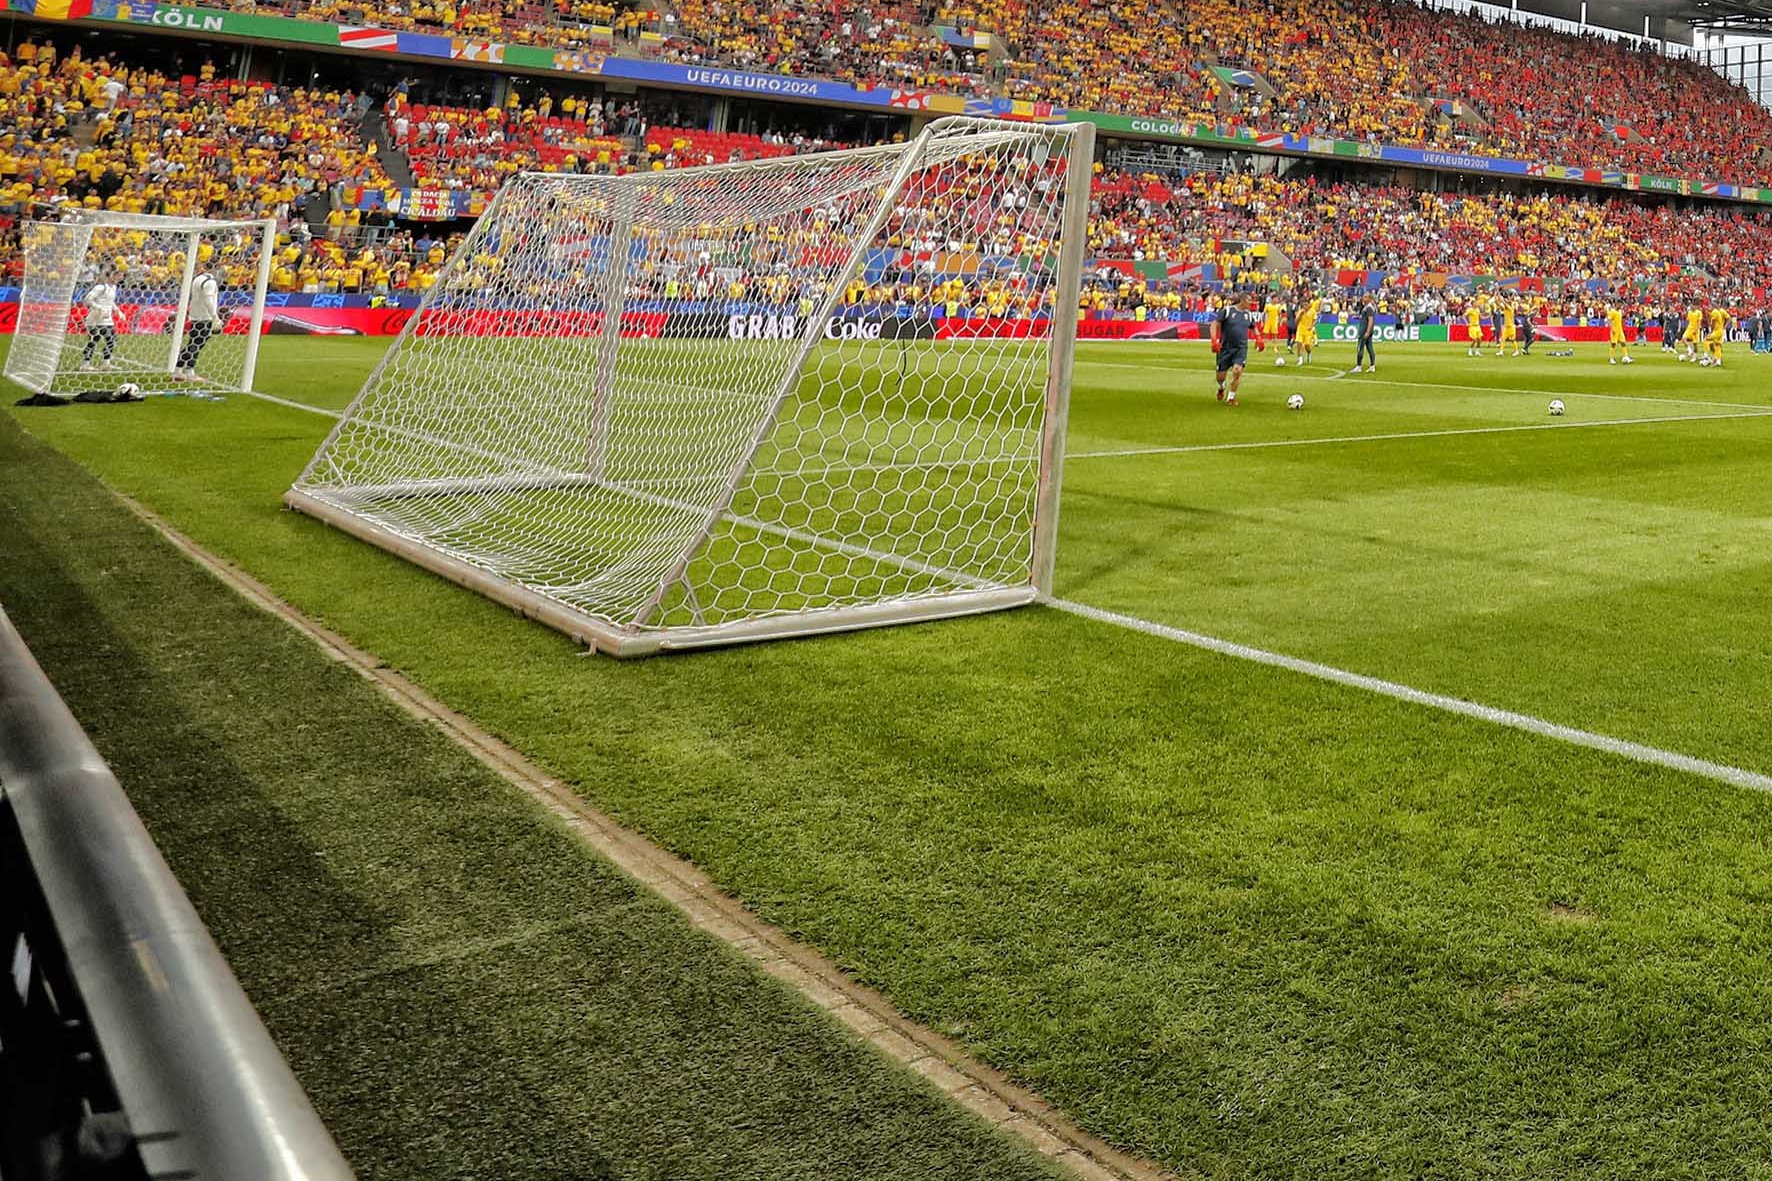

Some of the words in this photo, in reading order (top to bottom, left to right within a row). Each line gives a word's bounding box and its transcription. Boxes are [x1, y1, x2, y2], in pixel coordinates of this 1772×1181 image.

[1650, 177, 1673, 189] KÖLN
[825, 315, 881, 340] Coke
[1333, 325, 1420, 340] COOGNE
